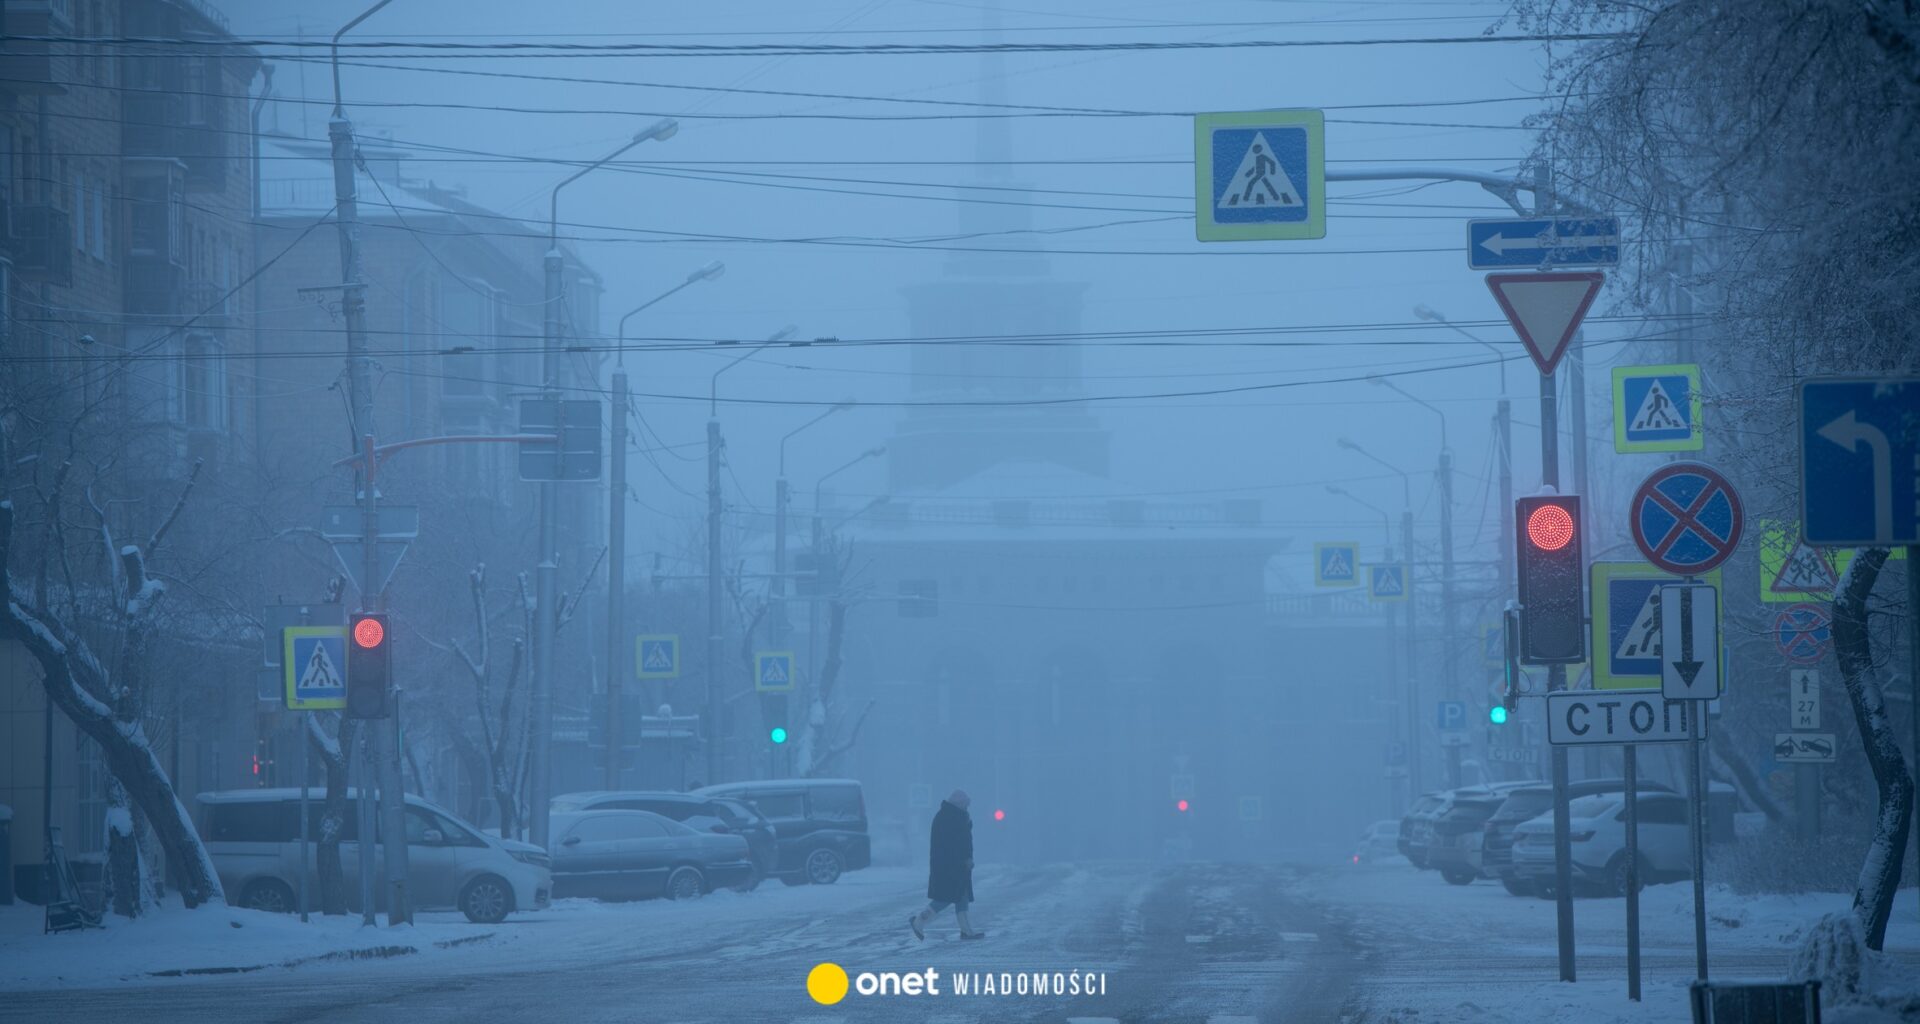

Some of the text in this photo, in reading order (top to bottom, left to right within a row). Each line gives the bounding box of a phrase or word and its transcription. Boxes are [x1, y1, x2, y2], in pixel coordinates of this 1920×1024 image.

[1444, 704, 1462, 727] P
[1566, 700, 1687, 736] СТОП
[1798, 701, 1815, 713] 27
